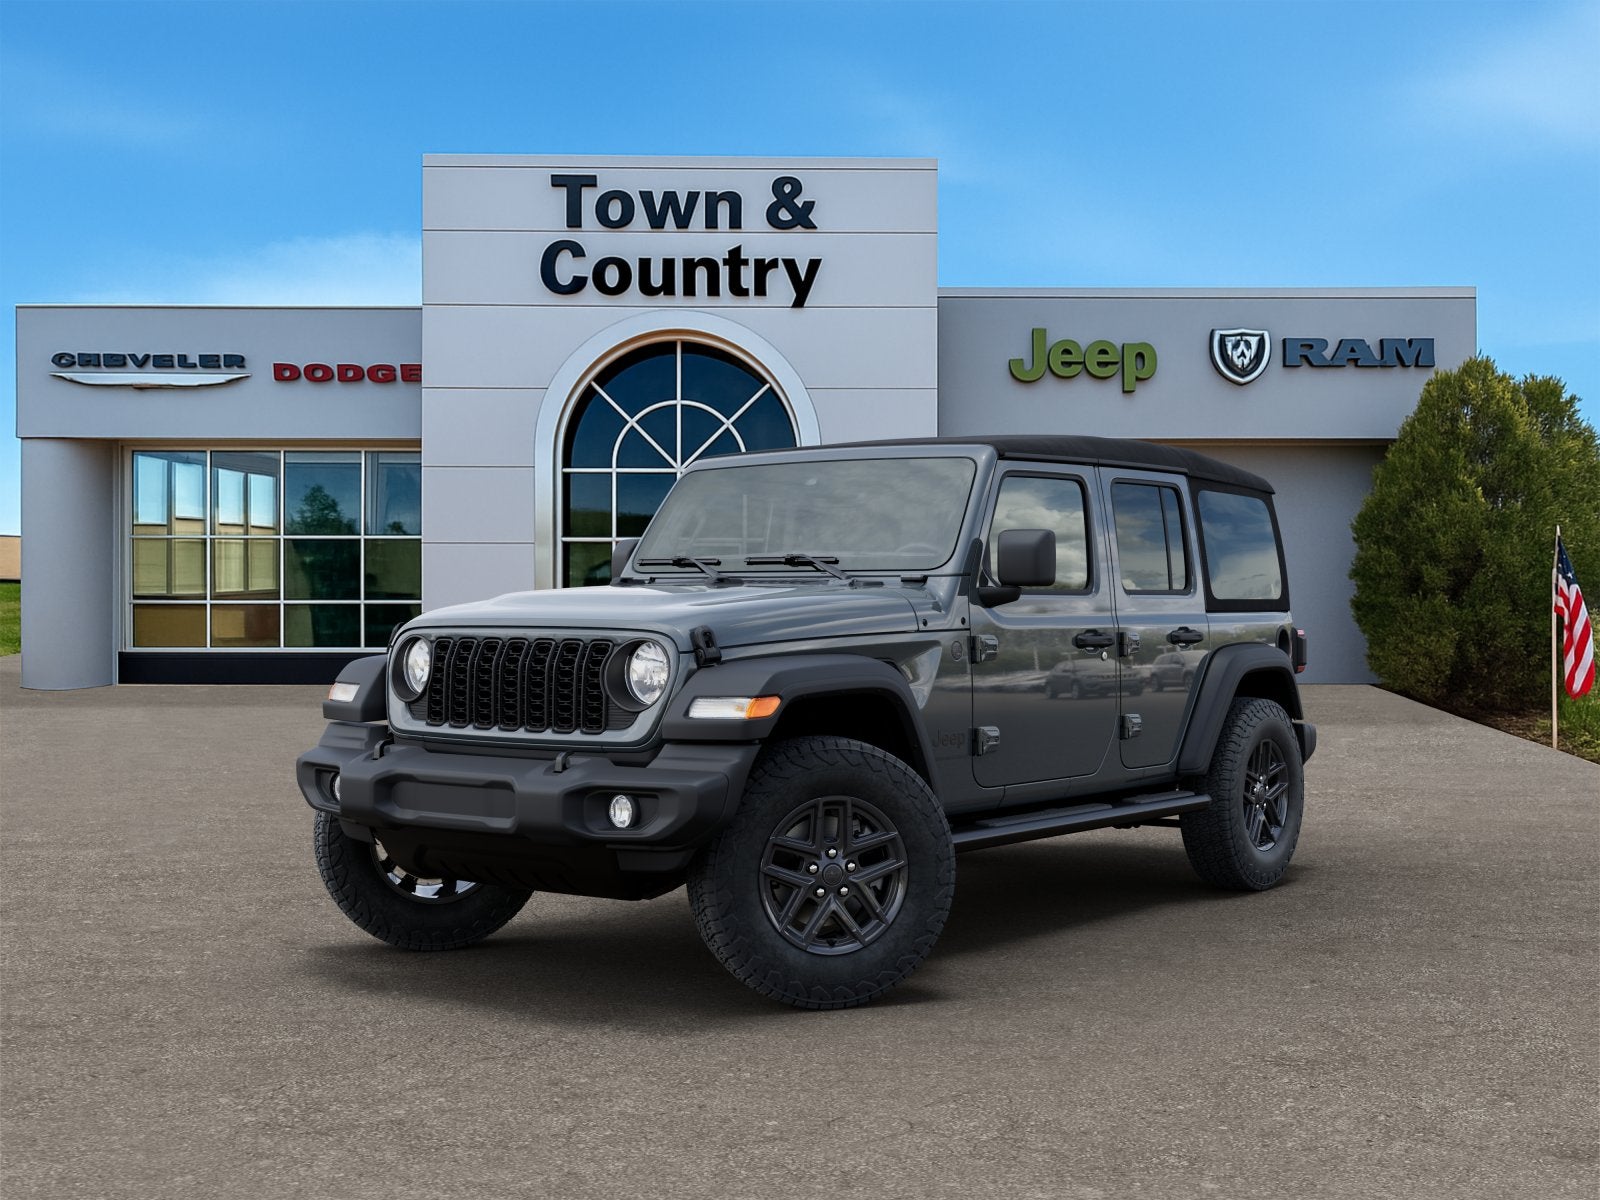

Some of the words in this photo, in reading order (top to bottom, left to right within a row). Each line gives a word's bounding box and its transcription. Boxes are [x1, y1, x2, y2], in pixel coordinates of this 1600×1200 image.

[550, 174, 742, 229] Town
[766, 176, 818, 230] &
[540, 239, 822, 308] Country
[273, 362, 422, 383] DODGE
[1009, 327, 1157, 392] Jeep
[1282, 337, 1436, 368] RAM
[931, 728, 966, 749] Jeep
